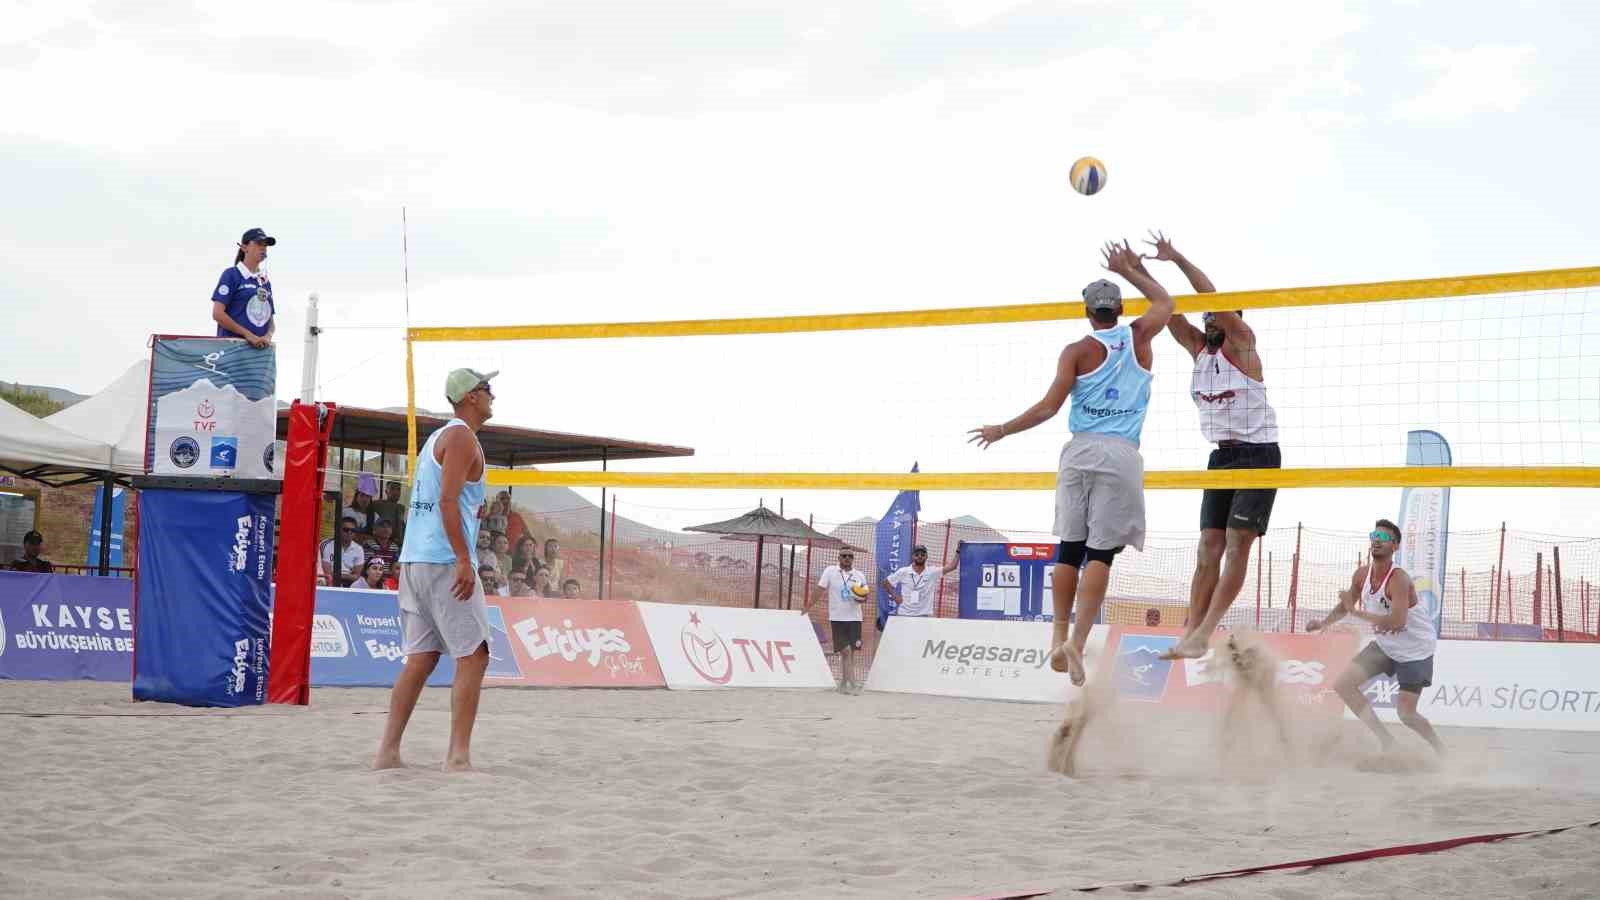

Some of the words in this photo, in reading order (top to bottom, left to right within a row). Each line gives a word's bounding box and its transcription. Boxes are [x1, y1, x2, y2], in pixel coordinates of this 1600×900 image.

[193, 421, 217, 431] TVF
[233, 515, 251, 570] Erciyes
[257, 516, 267, 552] Kayseri
[257, 554, 266, 580] Etabı
[985, 571, 992, 583] 0
[1001, 571, 1015, 583] 16
[356, 614, 396, 628] Kayseri
[15, 632, 113, 653] BÜYÜKŞEHİR
[512, 616, 632, 667] Erciyes
[921, 639, 1053, 669] Megasaray
[732, 637, 796, 674] TVF
[940, 664, 1022, 678] HOTELS
[1431, 683, 1484, 708] AXA
